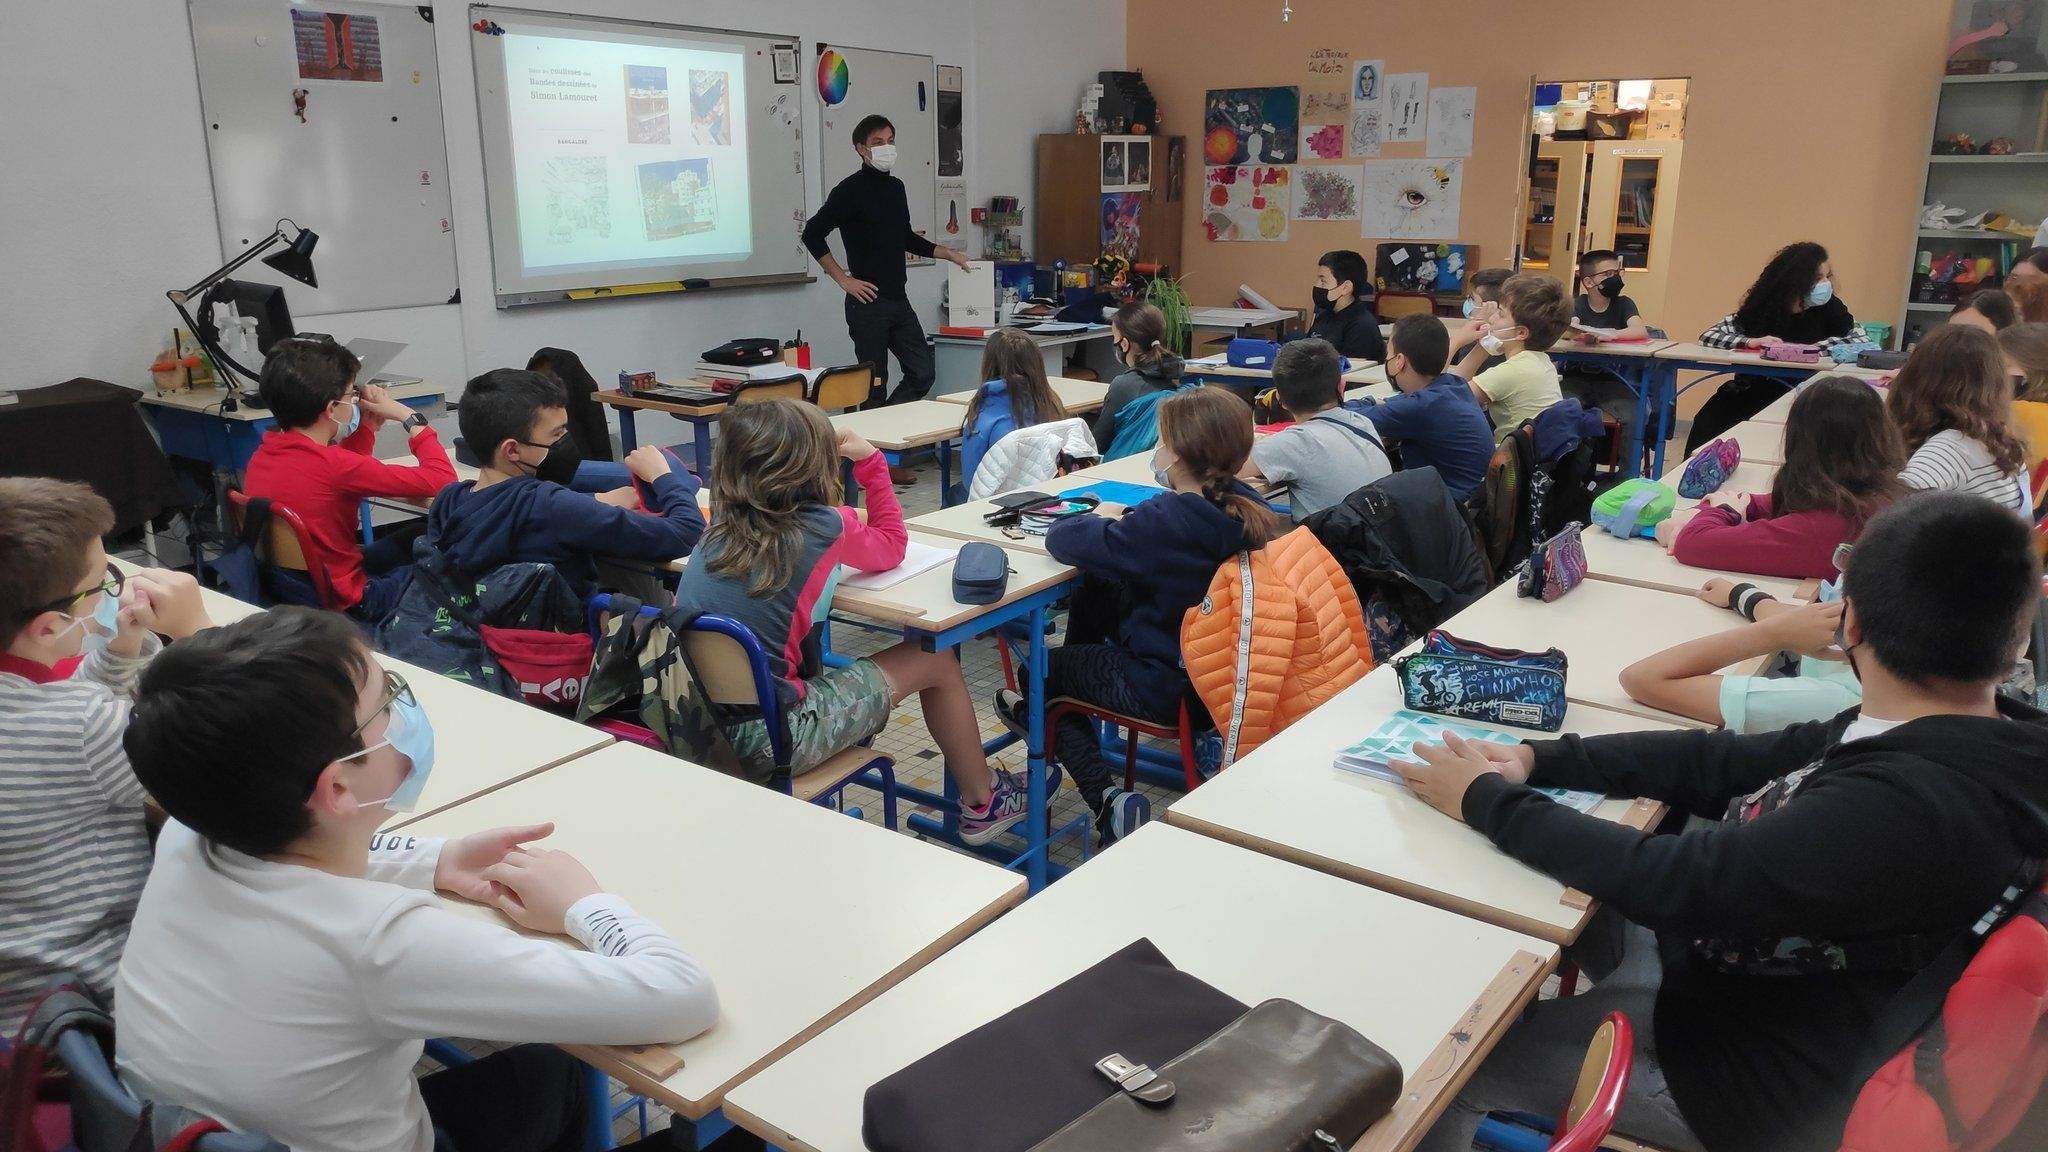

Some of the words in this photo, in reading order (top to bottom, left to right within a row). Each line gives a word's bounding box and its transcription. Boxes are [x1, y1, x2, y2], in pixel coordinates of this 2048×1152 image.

[550, 66, 581, 76] coulisses
[530, 91, 557, 100] Simon
[559, 92, 598, 102] Lamouret
